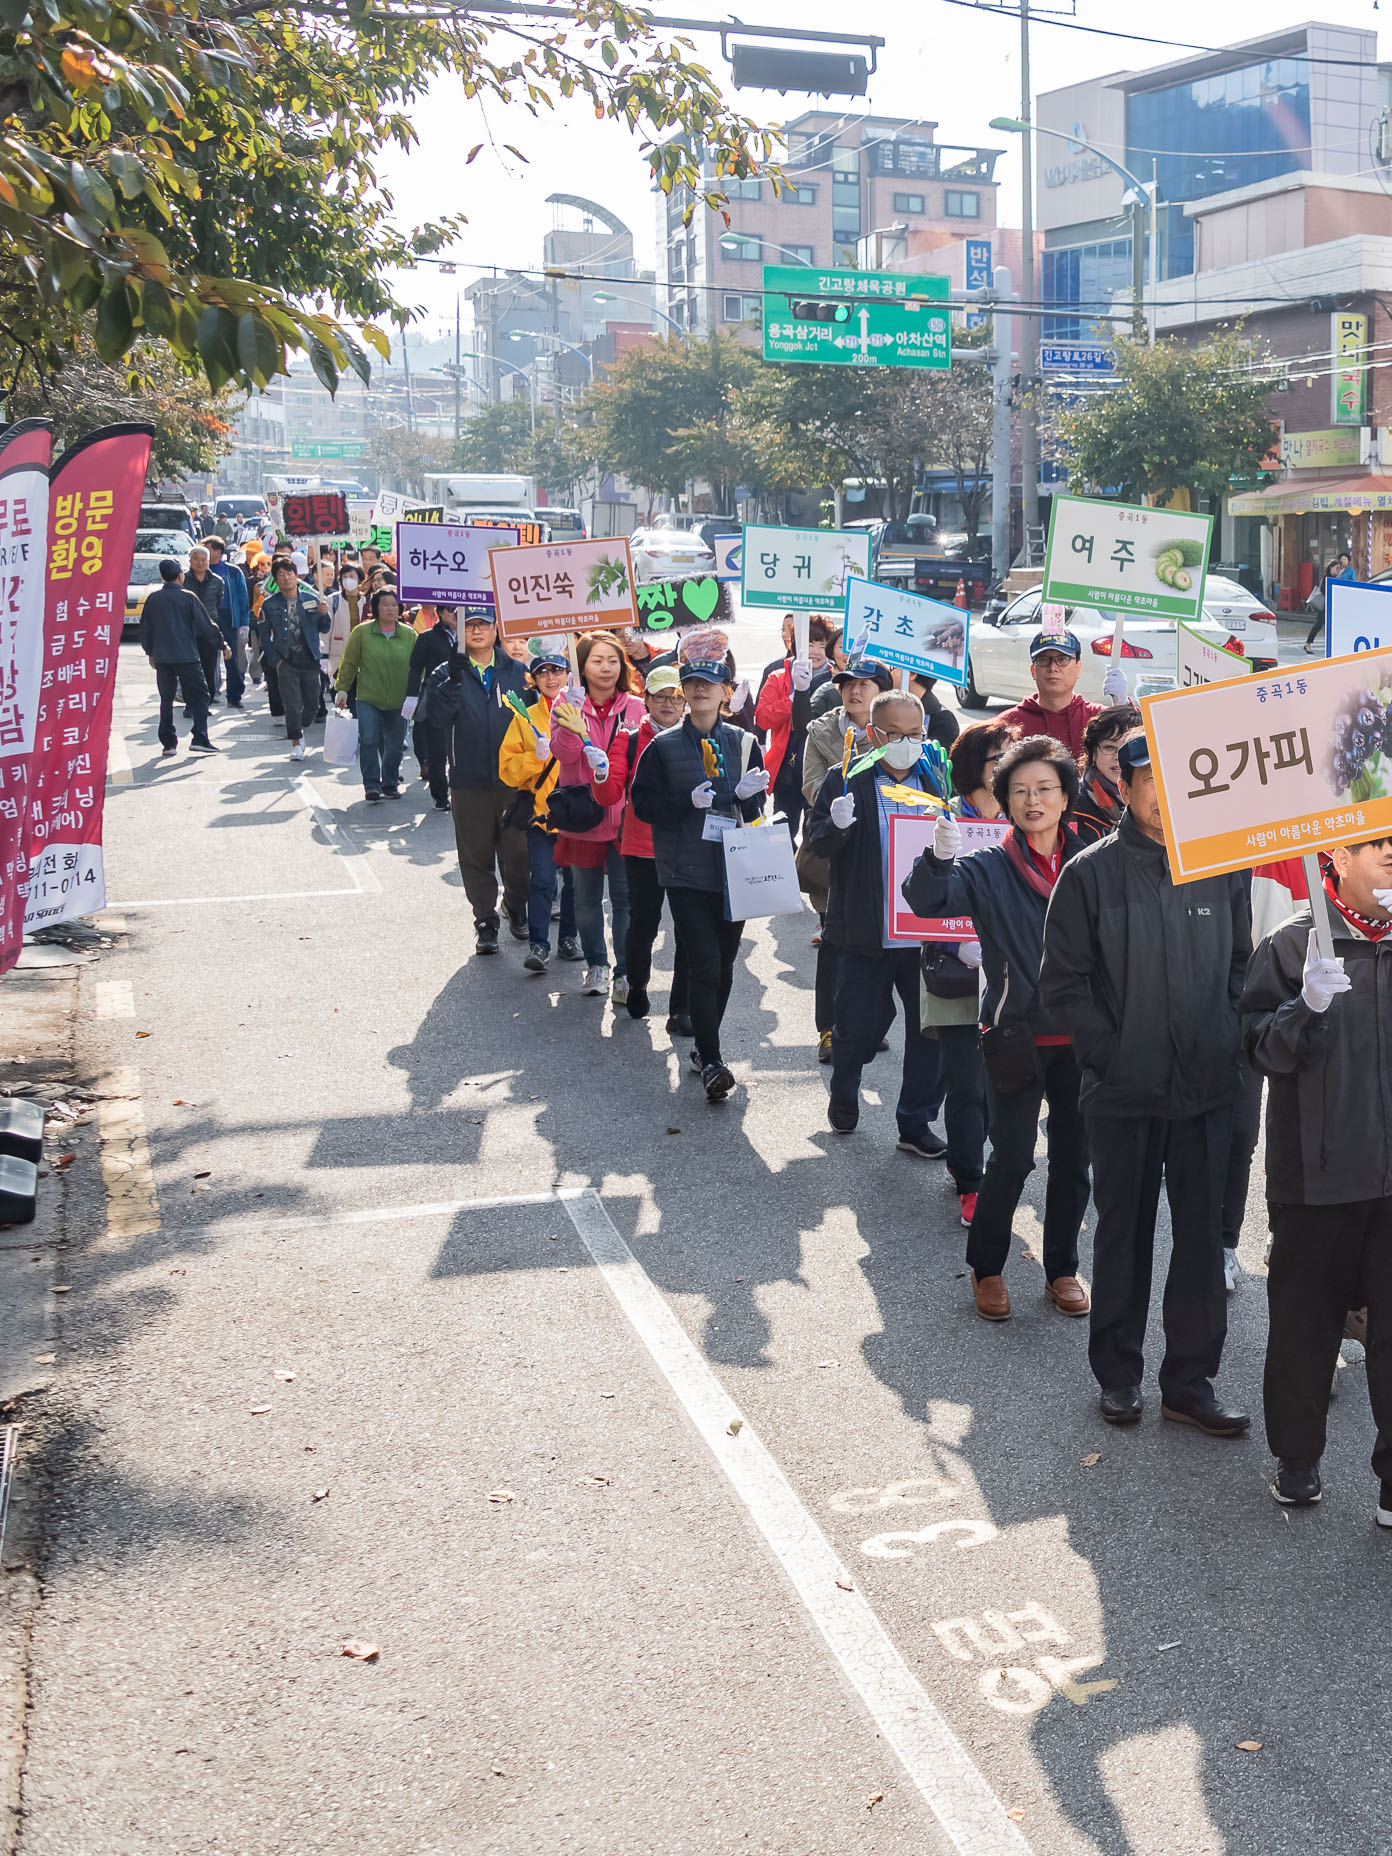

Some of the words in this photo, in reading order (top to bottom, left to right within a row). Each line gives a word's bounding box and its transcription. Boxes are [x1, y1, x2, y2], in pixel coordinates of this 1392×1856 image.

[767, 323, 833, 342] 용곡삼거리
[895, 331, 947, 348] 아차산역
[768, 340, 803, 352] Yonggok
[806, 341, 819, 352] Jct
[896, 347, 930, 358] Achasan
[932, 348, 947, 359] Stn
[851, 353, 878, 365] 200m
[54, 489, 114, 536] 방문
[1117, 510, 1149, 525] 중곡1동
[49, 535, 104, 581] 환영
[408, 548, 470, 576] 하수오
[507, 571, 575, 605] 인진쑥
[635, 581, 679, 631] 짱
[1087, 589, 1107, 601] 사람이
[1107, 592, 1133, 605] 아름다운
[1134, 595, 1160, 608] 약초마을
[1255, 677, 1309, 704] 중곡1동
[1186, 726, 1314, 800] 오가피
[966, 826, 1002, 839] 중곡1동
[1246, 828, 1278, 848] 사람이
[1279, 819, 1322, 841] 아름다운
[1324, 810, 1366, 832] 약초마을
[1197, 906, 1211, 916] K2
[941, 918, 964, 930] 사람이
